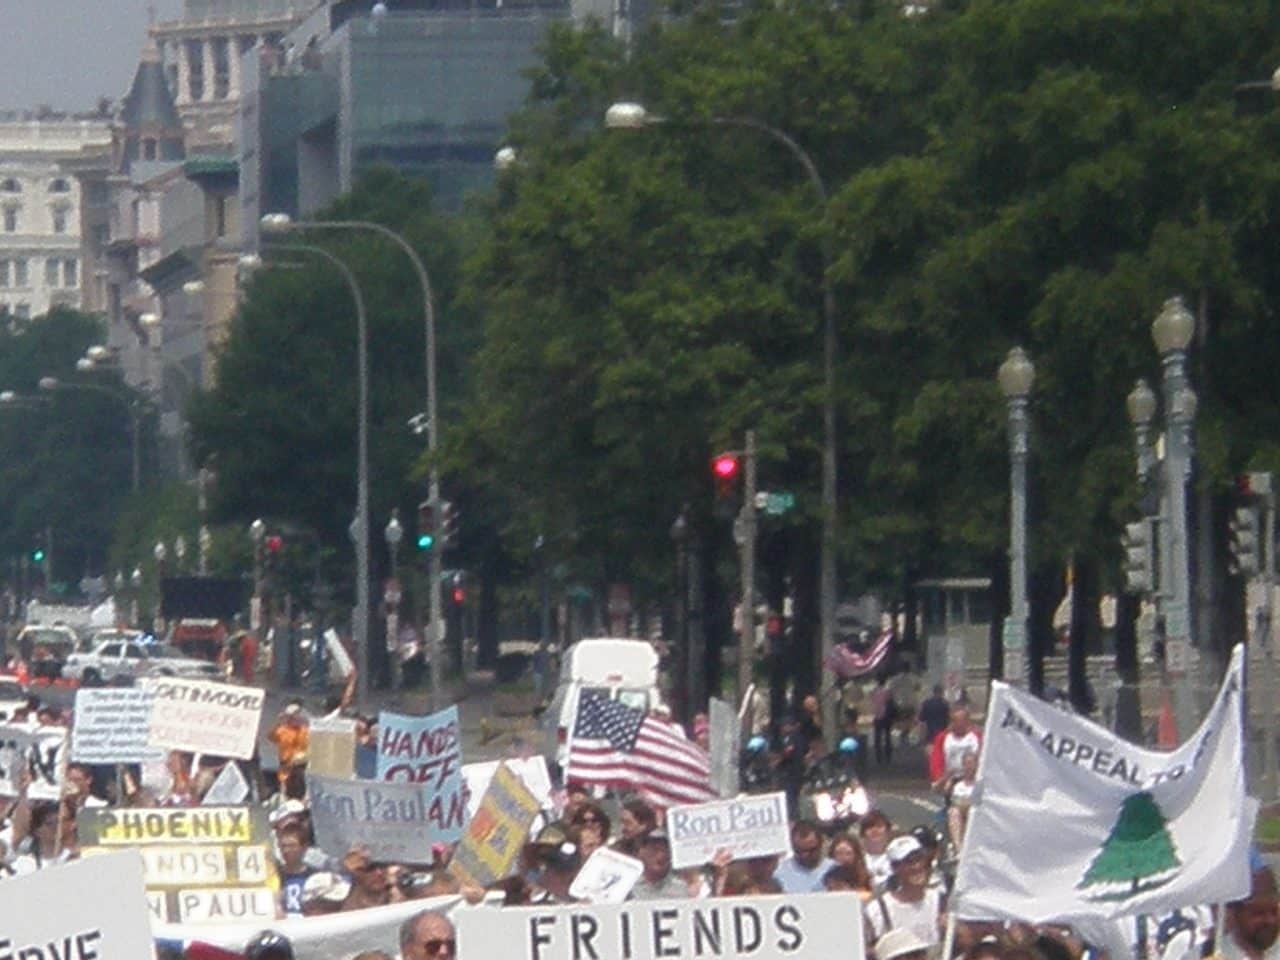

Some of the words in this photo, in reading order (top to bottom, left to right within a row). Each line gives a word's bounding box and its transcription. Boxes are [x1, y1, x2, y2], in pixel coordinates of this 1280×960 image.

[382, 721, 458, 758] HANDS
[1039, 730, 1144, 785] APPEAL
[429, 778, 471, 829] AN
[673, 811, 720, 840] Ron
[728, 797, 783, 832] Paul
[100, 810, 245, 839] PHOENIX
[244, 852, 262, 875] 4
[184, 894, 268, 918] PAUL
